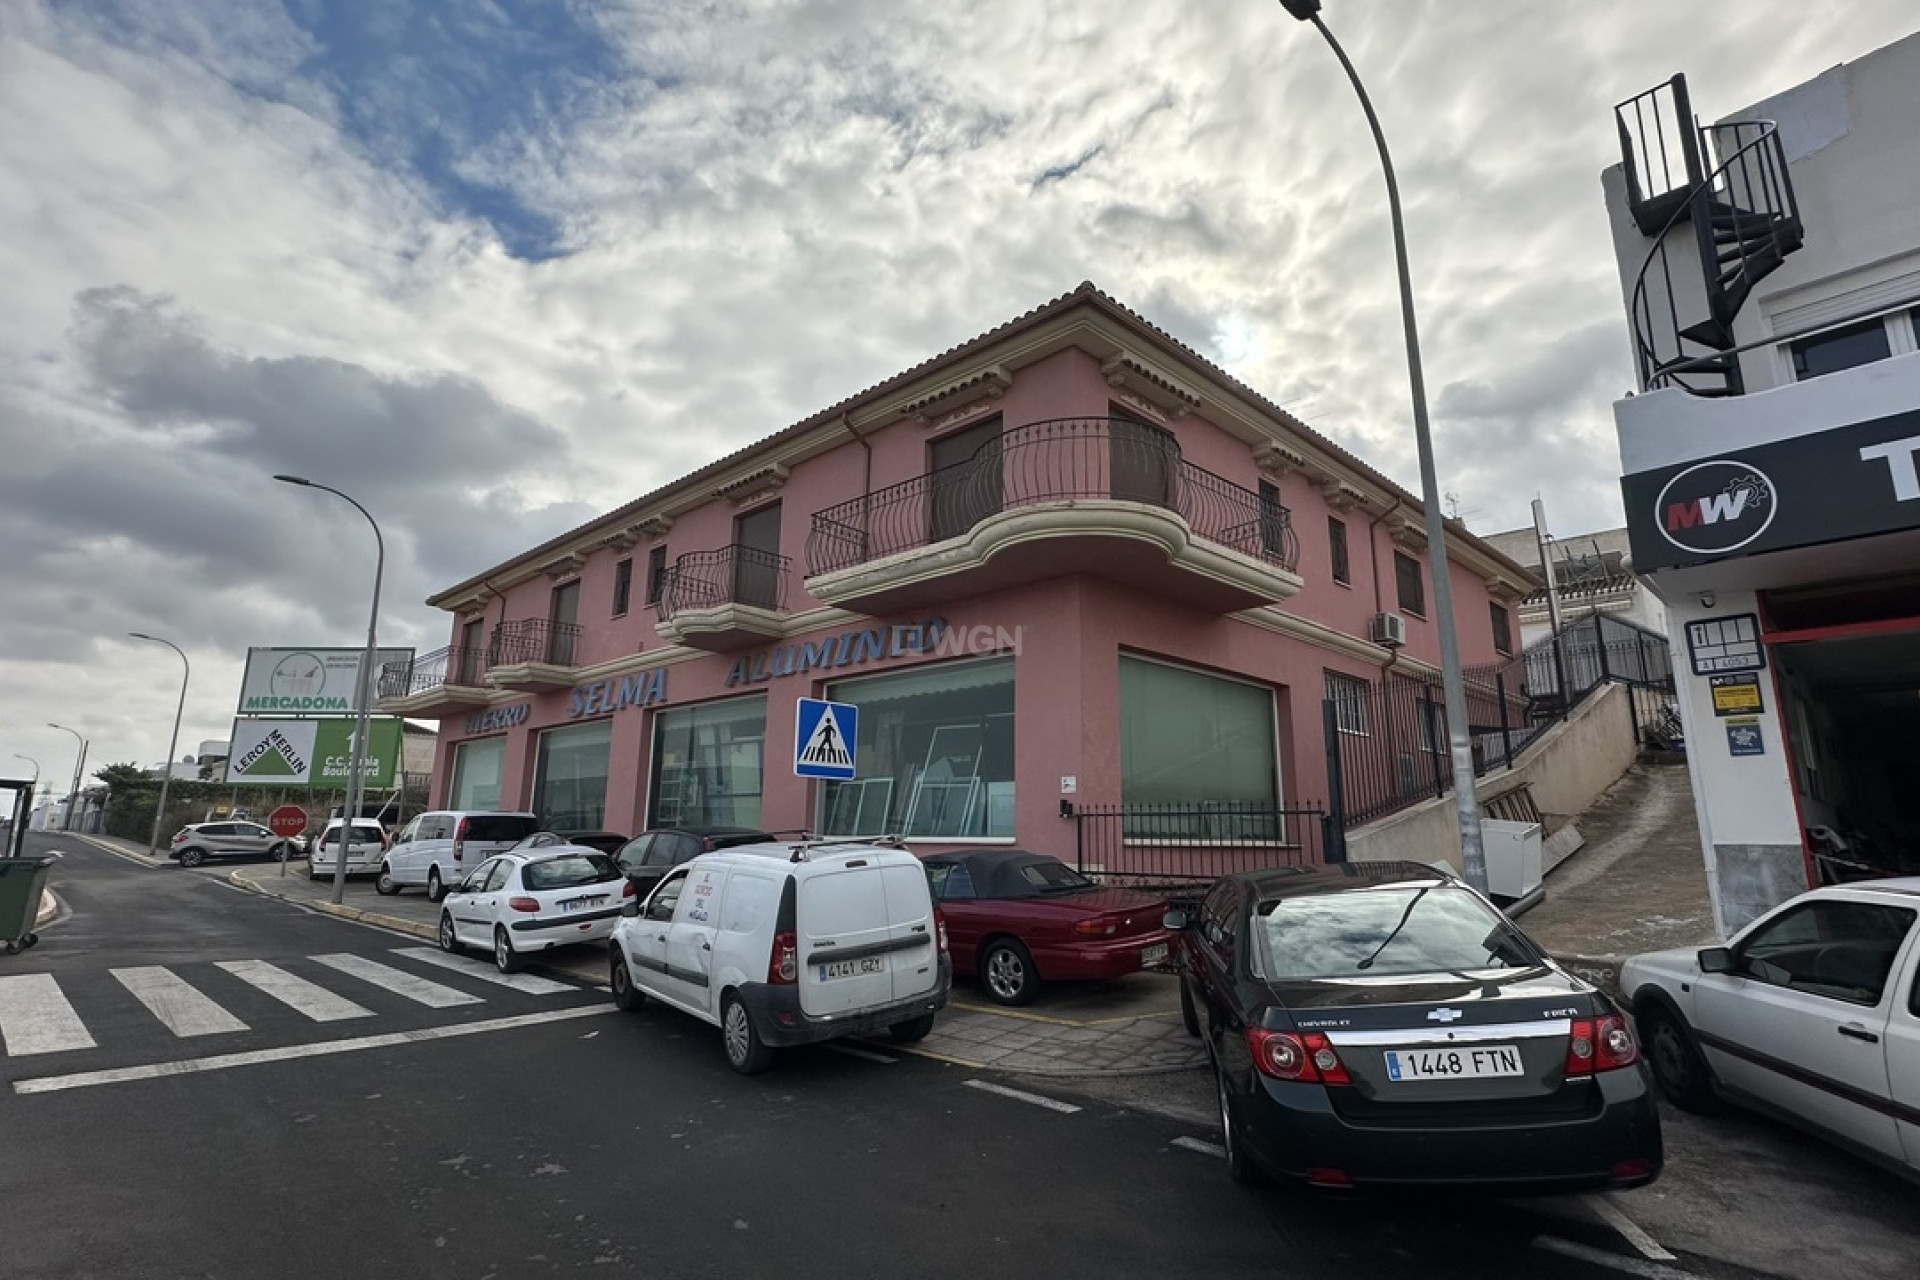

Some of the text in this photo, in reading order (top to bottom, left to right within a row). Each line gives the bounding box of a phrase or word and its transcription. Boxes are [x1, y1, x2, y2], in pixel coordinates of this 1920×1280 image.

[1859, 435, 1920, 502] T
[1668, 489, 1750, 531] MW
[246, 696, 348, 709] MERCADONA
[567, 668, 668, 718] SELMA
[233, 729, 307, 774] LEROY MERLIN
[272, 817, 304, 826] STOP
[828, 957, 880, 977] 4141 GZY
[1408, 1051, 1518, 1076] 1448 FTN
